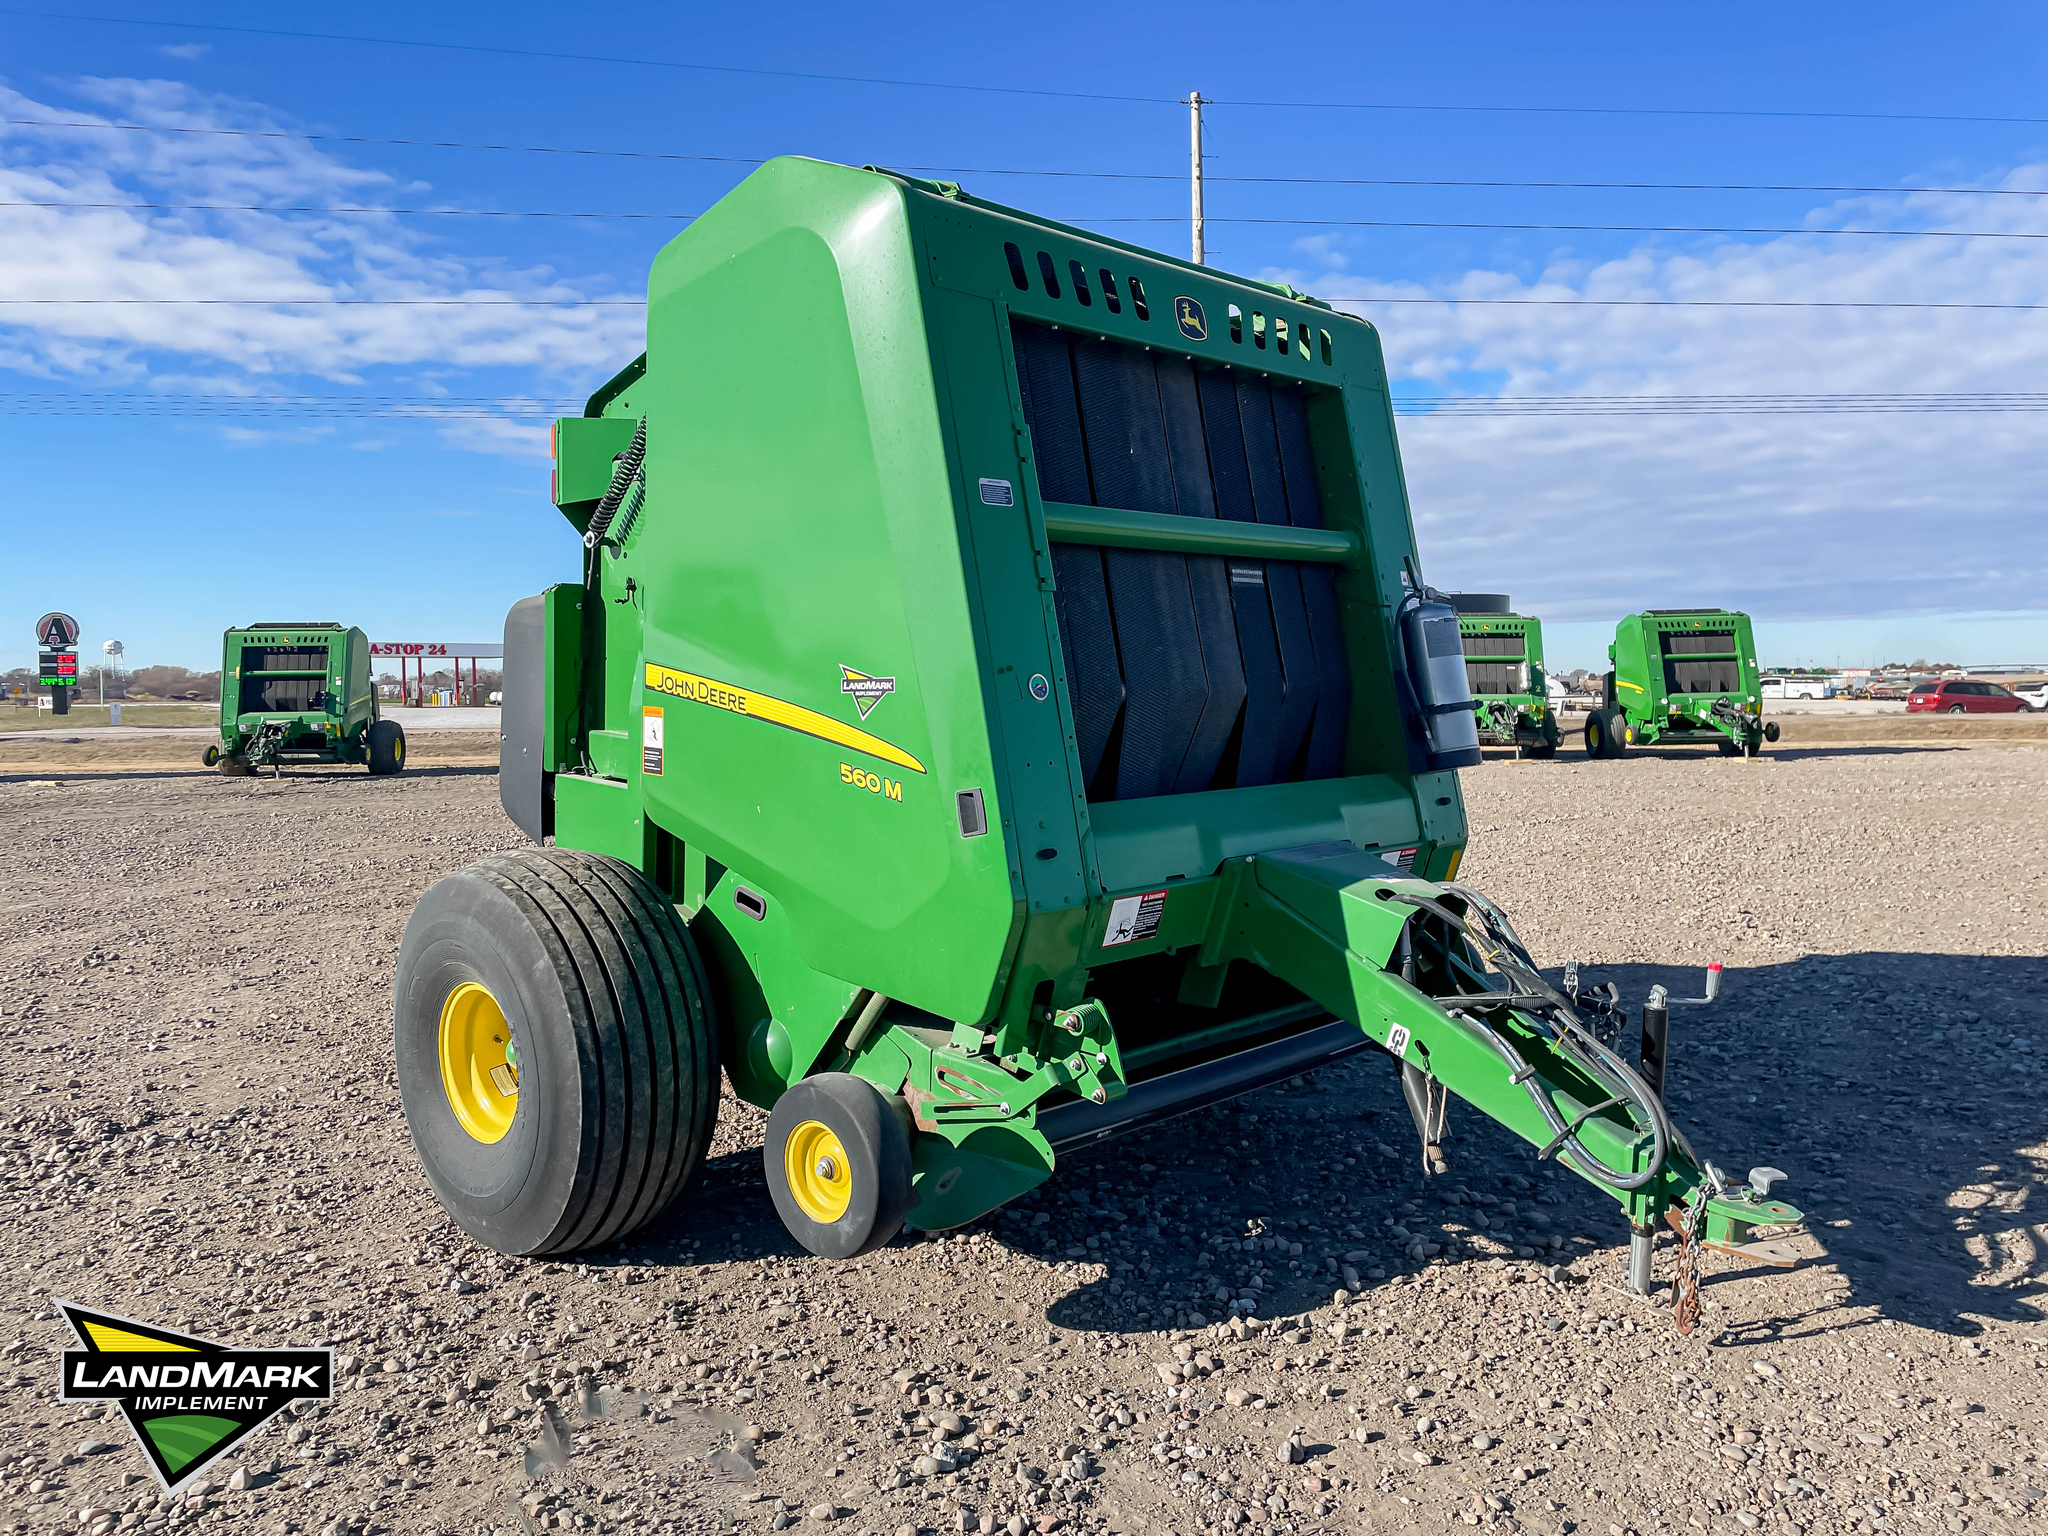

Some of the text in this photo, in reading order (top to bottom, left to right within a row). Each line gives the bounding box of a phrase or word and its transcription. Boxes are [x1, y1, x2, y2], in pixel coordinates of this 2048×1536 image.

[39, 617, 75, 644] A
[370, 643, 447, 655] A-STOP 24
[657, 672, 746, 711] JOHN DEERE
[840, 762, 903, 803] 560 M
